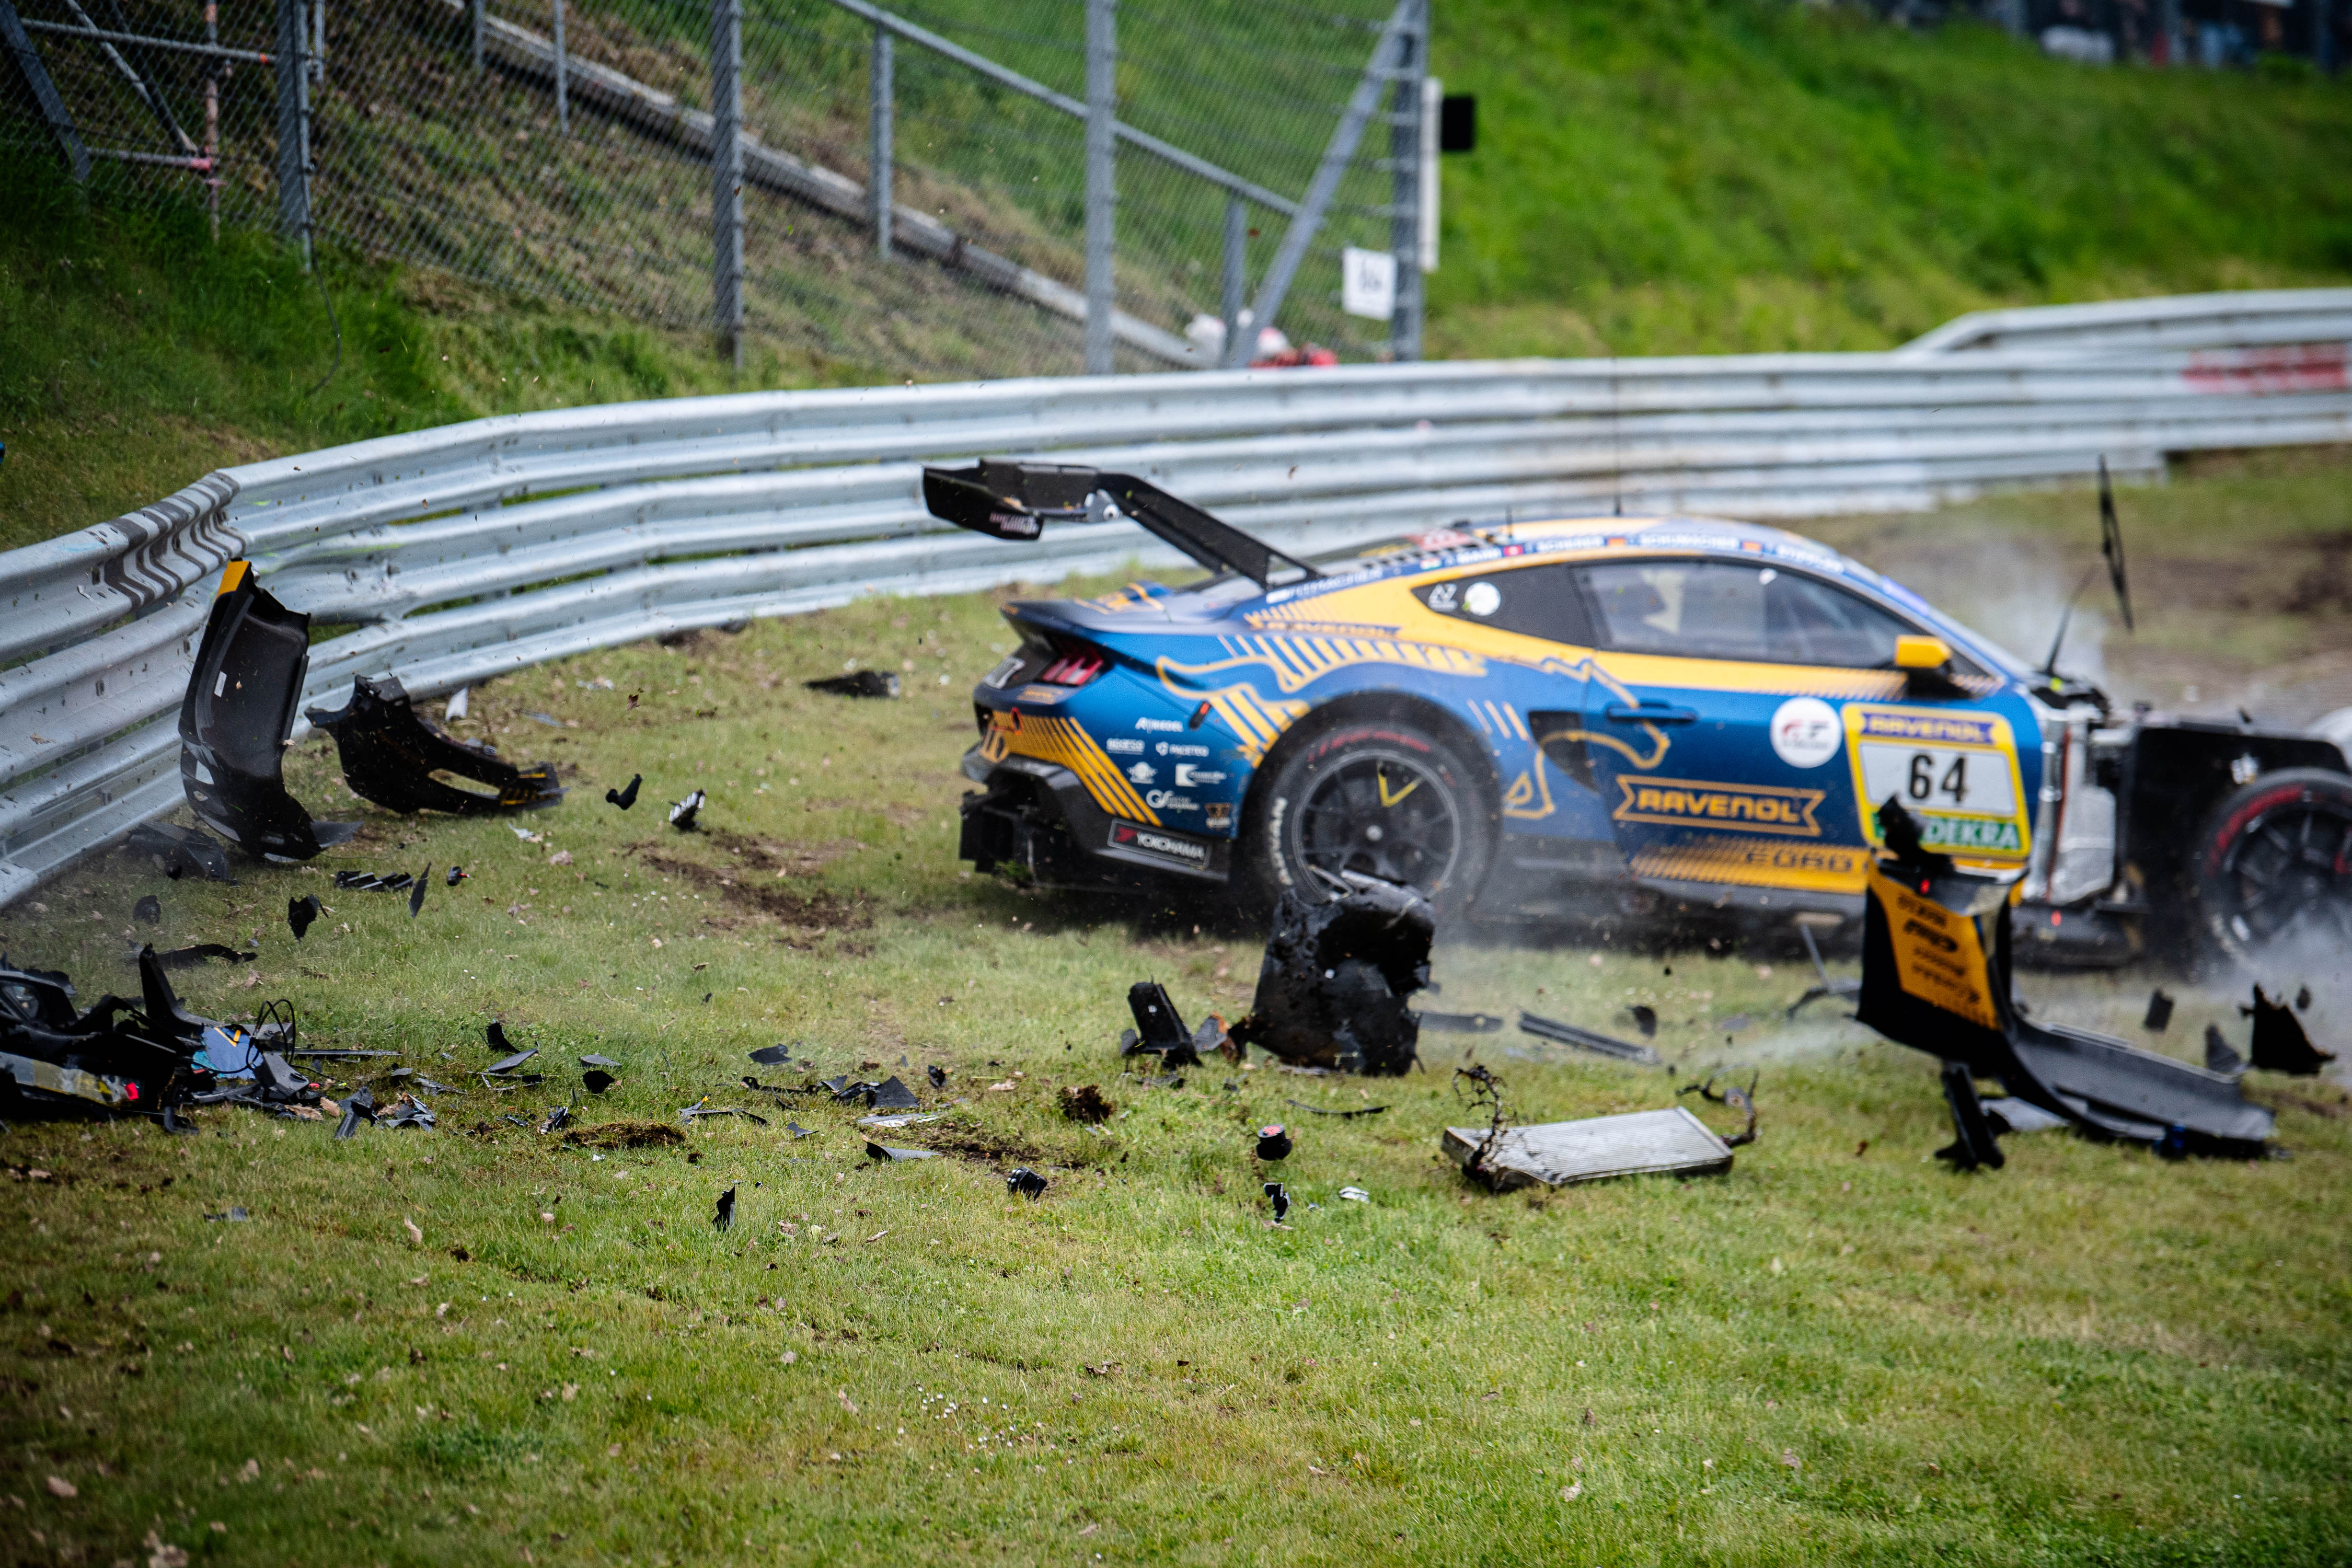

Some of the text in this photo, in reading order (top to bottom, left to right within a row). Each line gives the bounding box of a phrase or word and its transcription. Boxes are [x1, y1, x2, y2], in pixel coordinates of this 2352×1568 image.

[1640, 533, 1739, 549] SCHUMACHER
[1871, 717, 1984, 743] RAVENOL
[1909, 753, 1968, 802] 64
[1636, 788, 1800, 823] RAVENOL
[1136, 832, 1205, 860] YOKOHAMA
[1921, 816, 2021, 851] DEKRA
